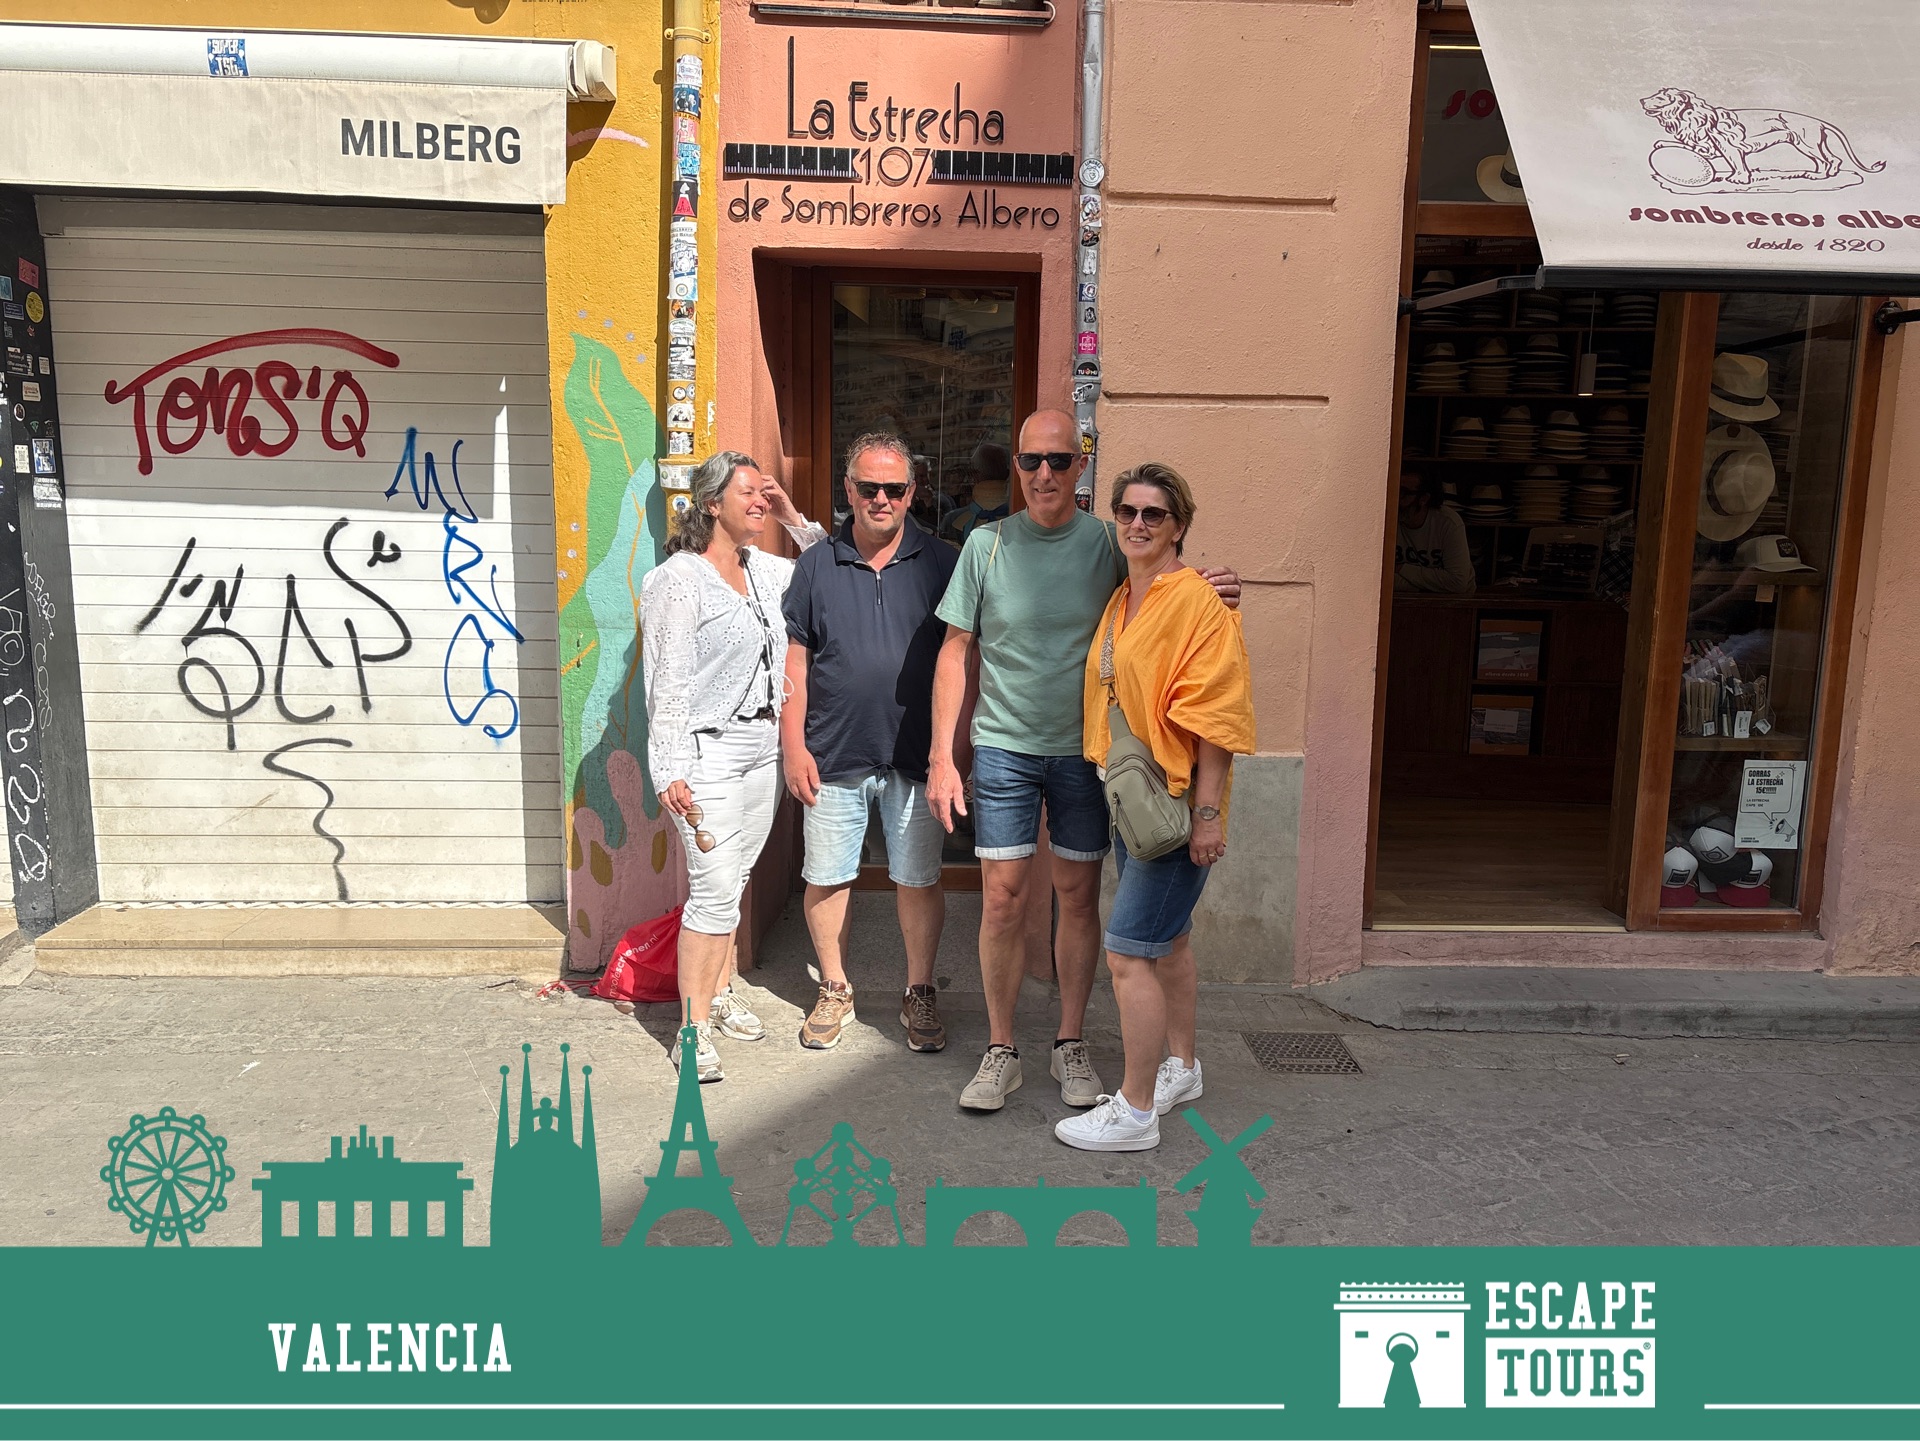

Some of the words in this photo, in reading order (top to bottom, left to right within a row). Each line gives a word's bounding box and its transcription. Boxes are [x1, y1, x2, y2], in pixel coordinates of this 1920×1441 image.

[788, 36, 834, 140] La
[848, 81, 1004, 144] Estrecha
[341, 118, 521, 165] MILBERG
[728, 181, 770, 223] de
[781, 184, 942, 227] Sombreros
[957, 188, 1060, 229] Albero
[1628, 206, 1826, 229] sombreros
[1746, 238, 1804, 251] desde
[1813, 238, 1886, 253] 1820
